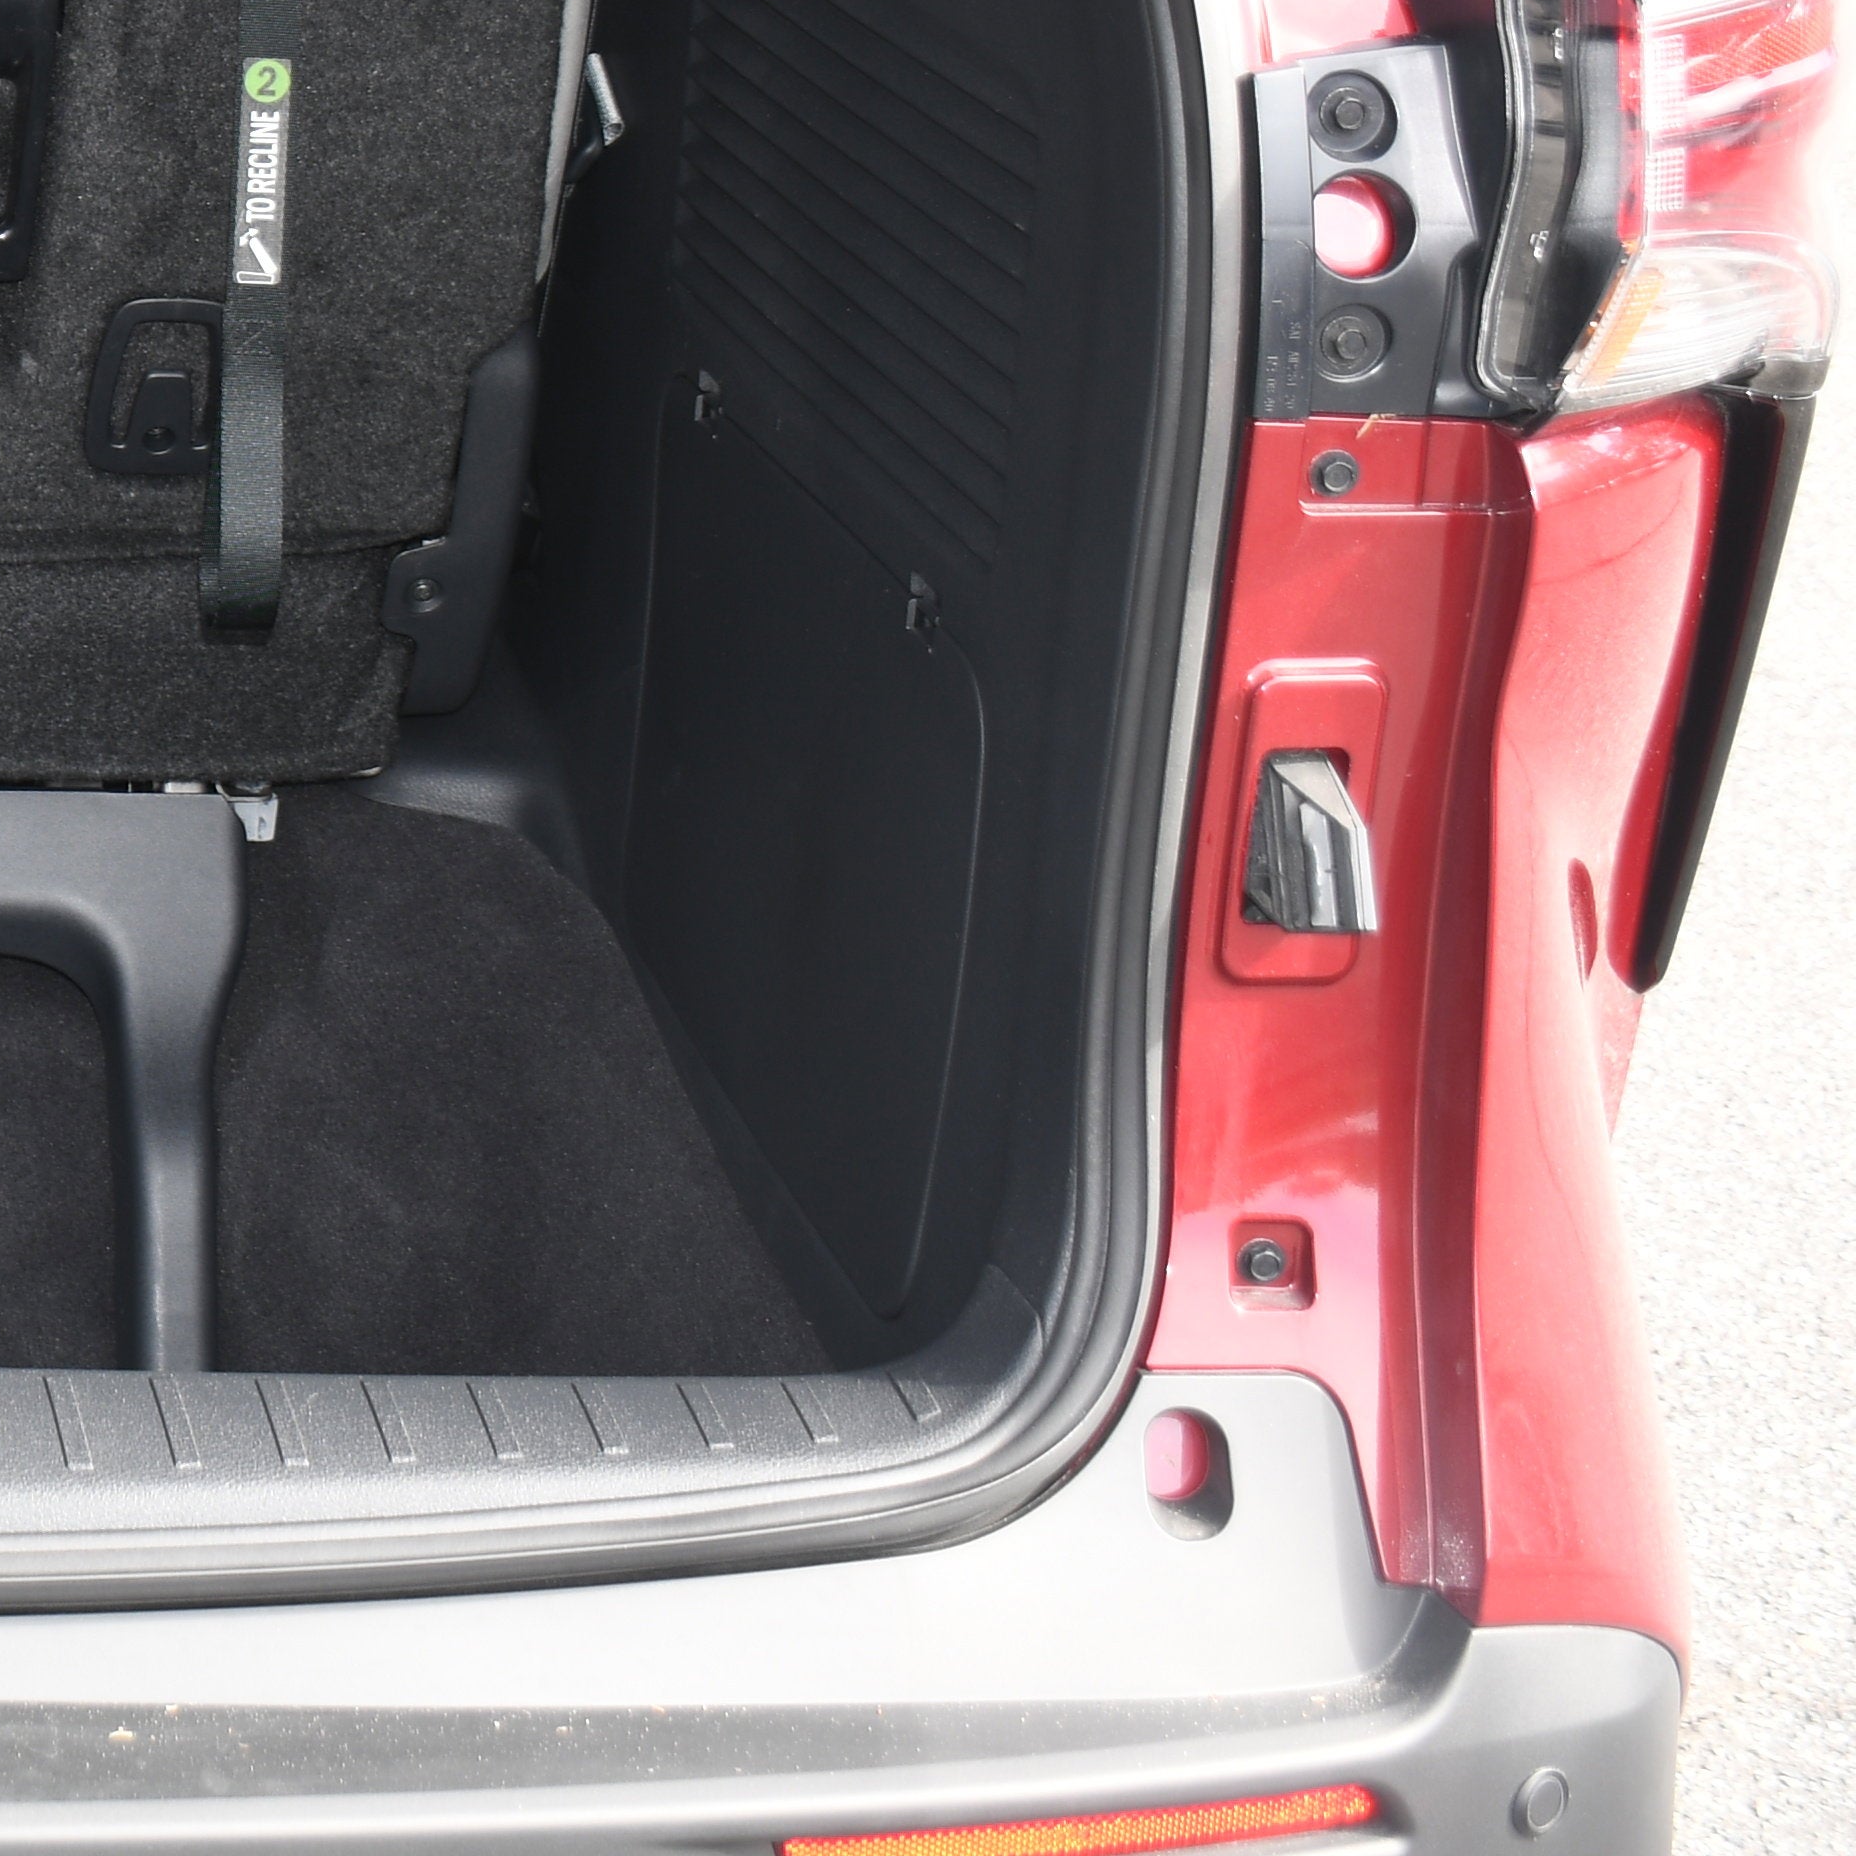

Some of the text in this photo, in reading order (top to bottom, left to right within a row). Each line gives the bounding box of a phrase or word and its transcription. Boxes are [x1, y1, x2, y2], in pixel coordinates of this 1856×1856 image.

[256, 65, 278, 97] 2
[245, 110, 281, 224] TO RECLINE
